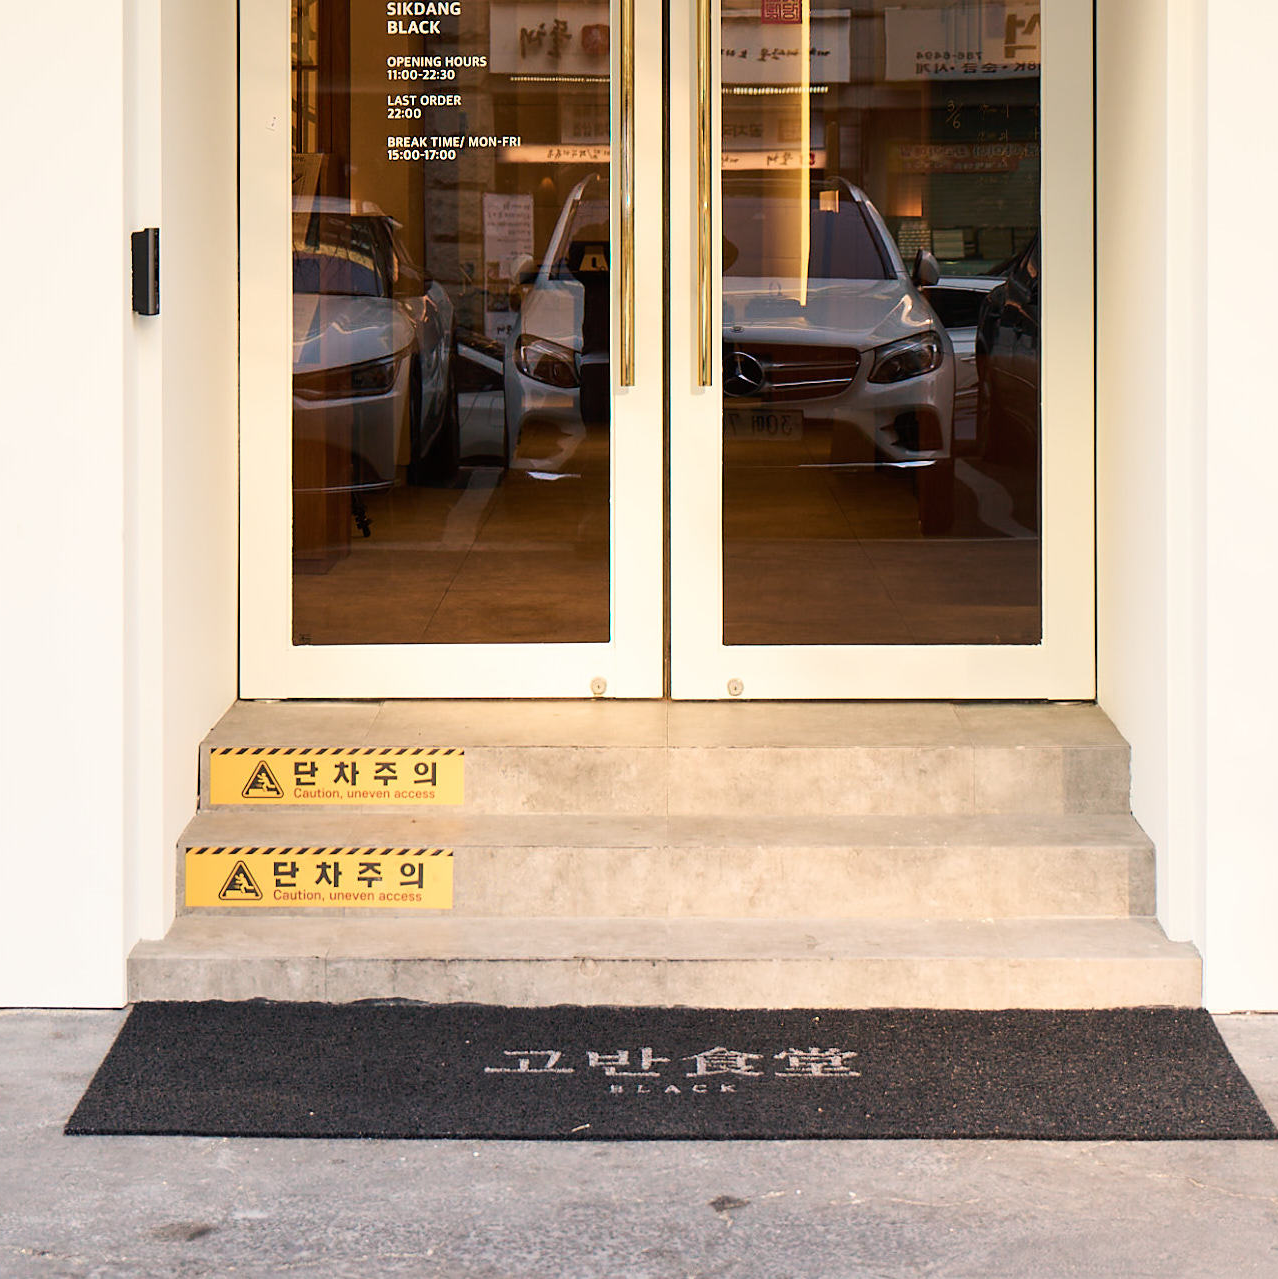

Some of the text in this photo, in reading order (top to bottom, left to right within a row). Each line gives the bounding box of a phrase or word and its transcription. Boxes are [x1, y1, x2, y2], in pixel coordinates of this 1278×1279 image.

[386, 2, 462, 16] SIKDANG
[387, 20, 441, 35] BLACK
[386, 56, 487, 67] OPENING HOURS
[387, 69, 456, 81] 11:00-22:30
[387, 95, 462, 106] LAST ORDER
[387, 108, 422, 119] 22:00
[387, 136, 521, 148] BREAK TIME/ MON-FRI
[387, 150, 457, 161] 15:00-17:00
[293, 761, 437, 787] 단차주의
[293, 787, 435, 800] Caution, uneven access
[273, 861, 425, 889] 단차주의
[273, 889, 422, 902] Caution, uneven access
[609, 1084, 737, 1094] BLACK
